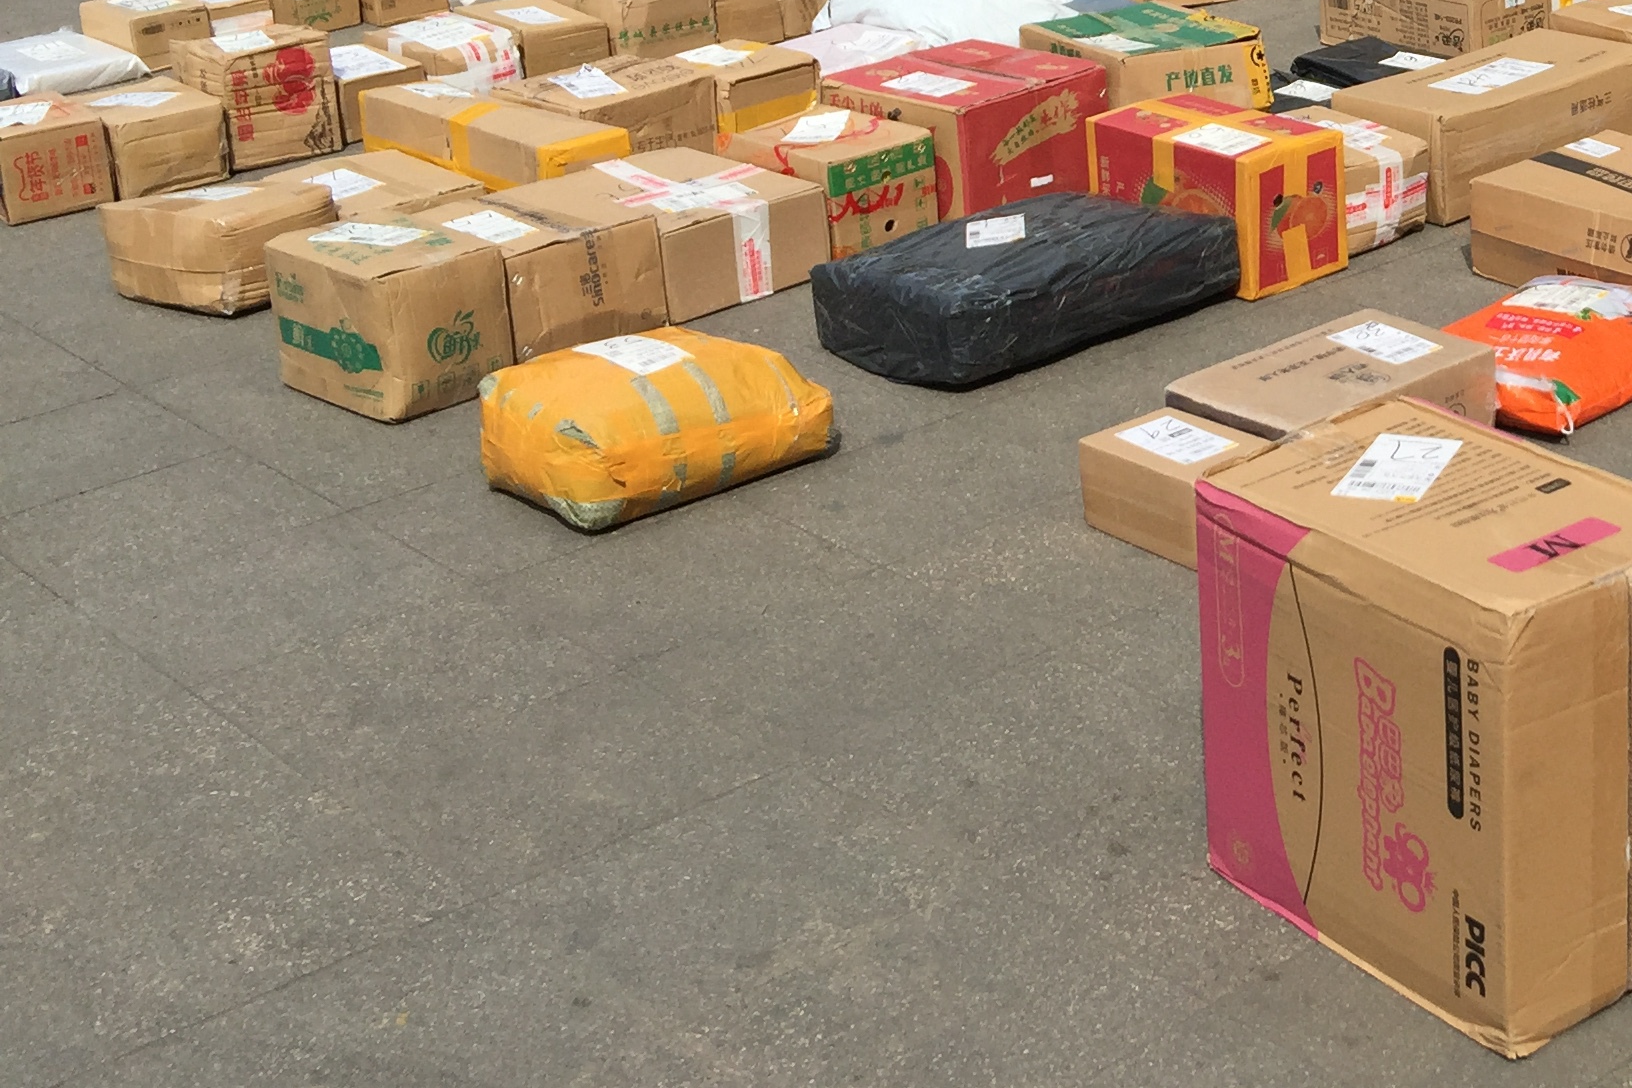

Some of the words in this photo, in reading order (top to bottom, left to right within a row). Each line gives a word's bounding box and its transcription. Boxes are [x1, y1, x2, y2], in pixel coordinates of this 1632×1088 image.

[1166, 64, 1234, 92] 产地直发
[1386, 439, 1445, 466] 27
[1218, 535, 1235, 566] M
[1530, 533, 1584, 563] M
[1466, 659, 1480, 721] BABY
[1287, 673, 1308, 803] Perfect
[1446, 660, 1461, 802] 婴儿医护级纸尿裤
[1468, 730, 1482, 832] DIAPERS
[1465, 913, 1486, 999] PICC
